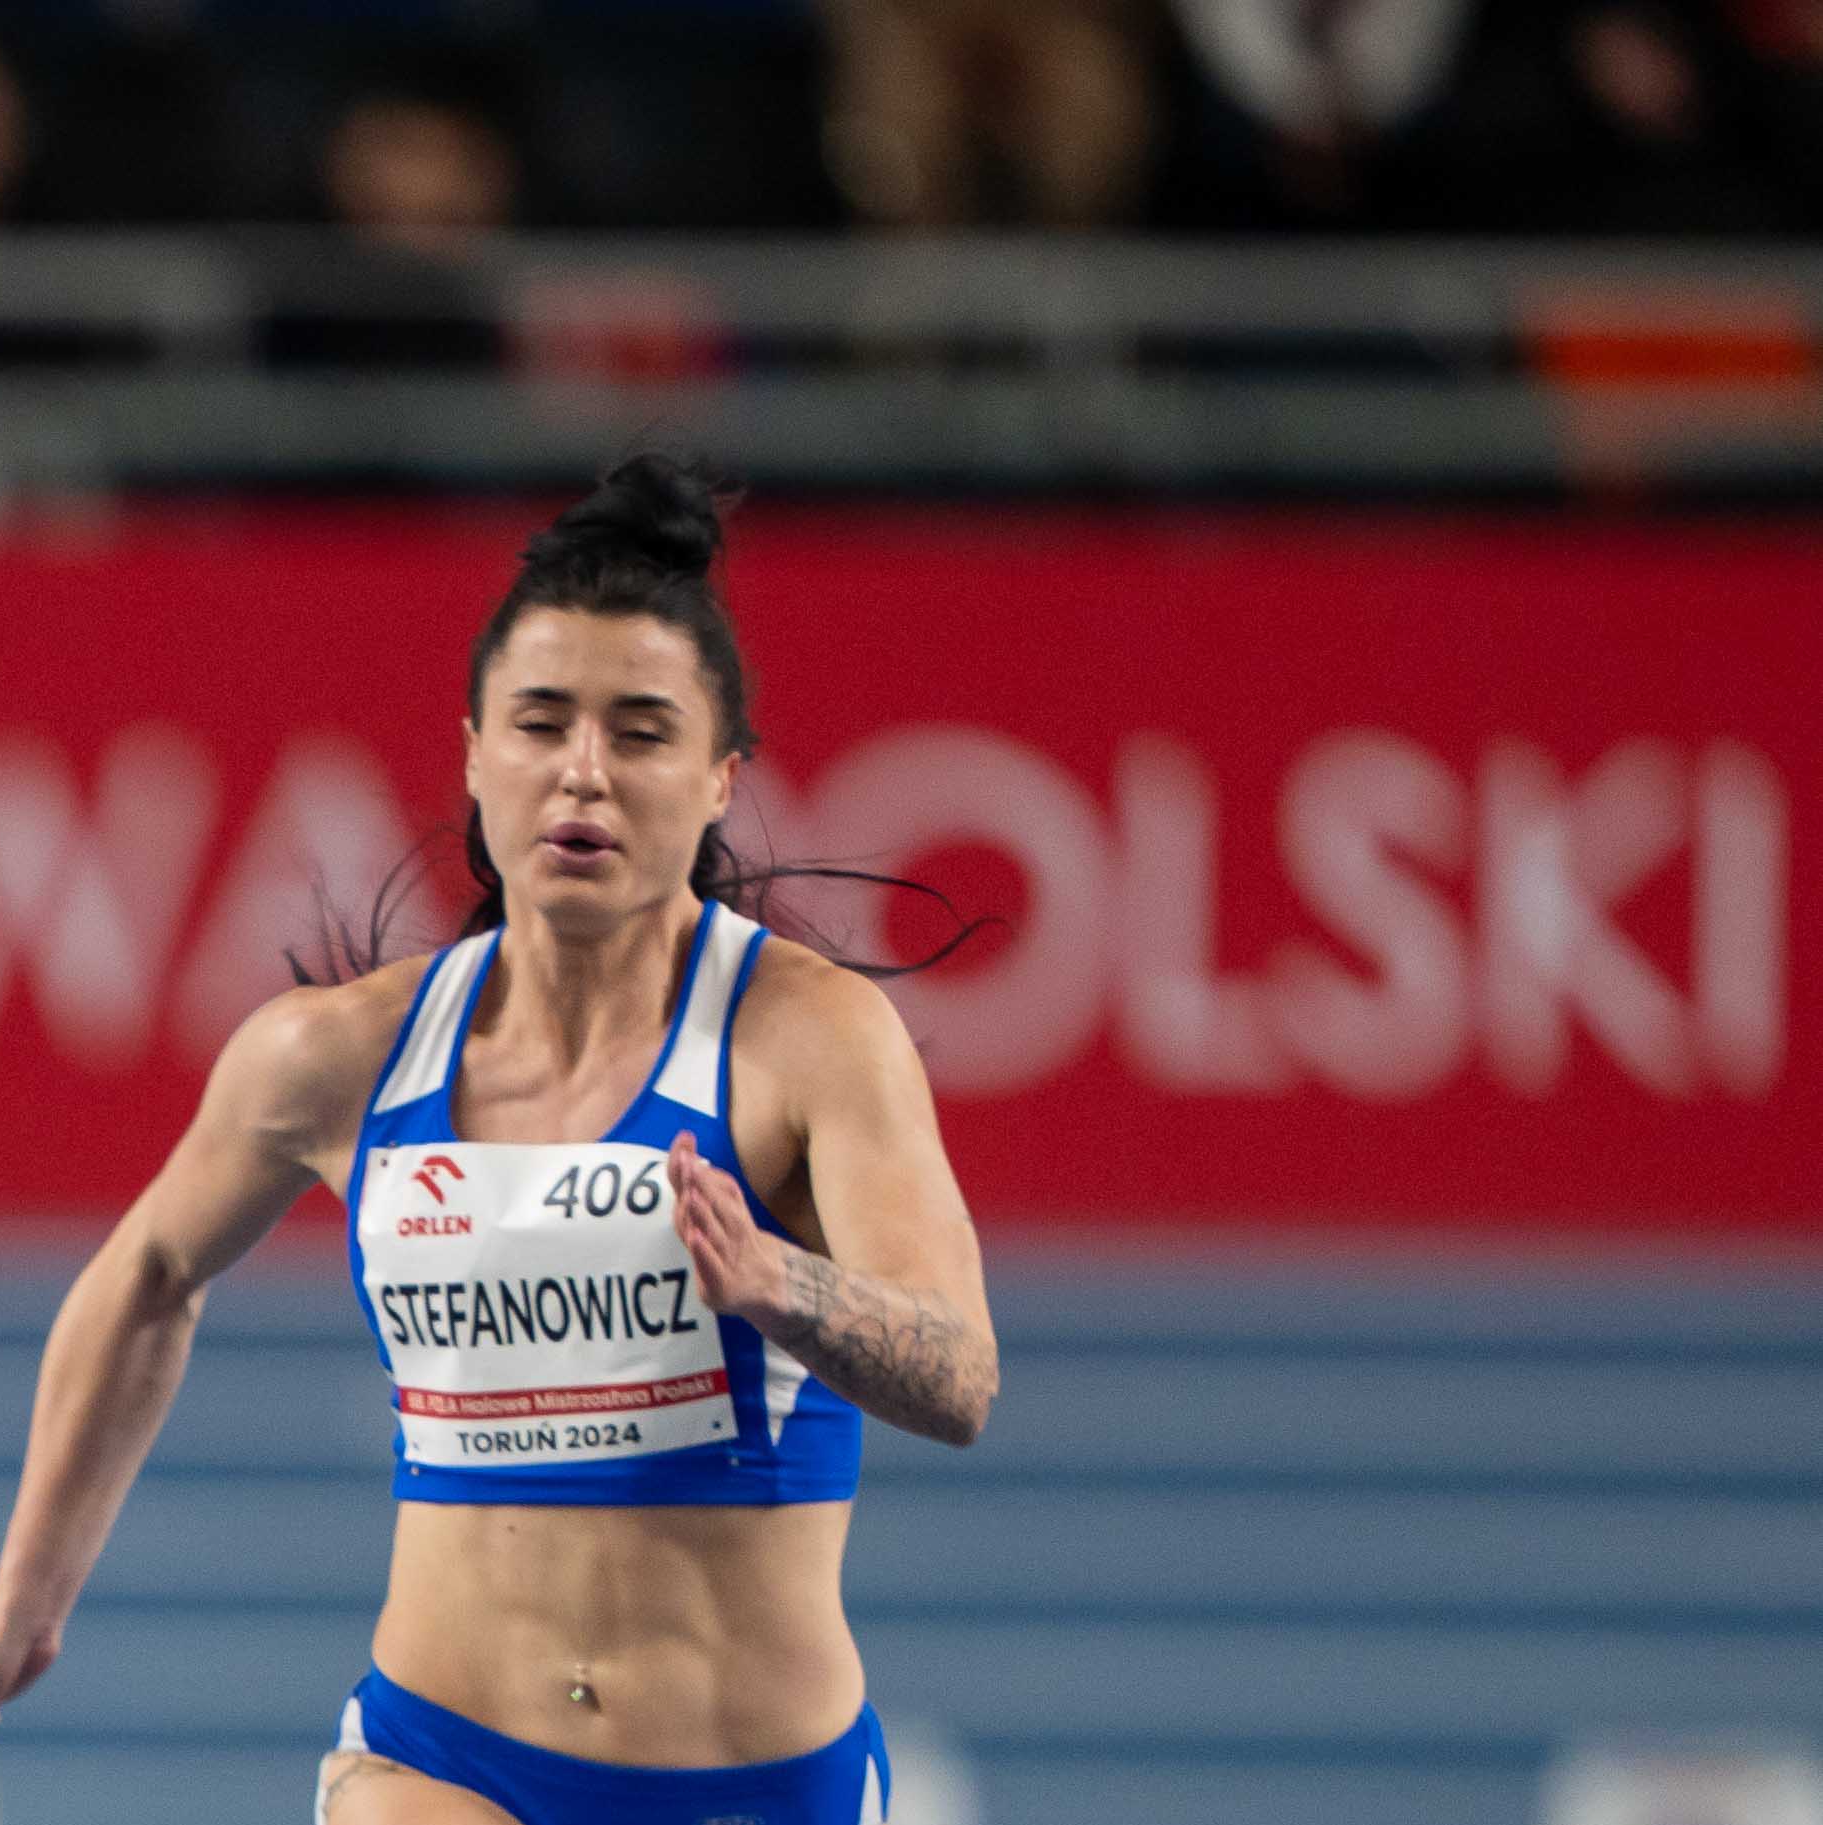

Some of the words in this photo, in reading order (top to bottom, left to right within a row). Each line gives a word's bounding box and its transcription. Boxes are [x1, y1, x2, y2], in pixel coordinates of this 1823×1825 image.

[730, 725, 1788, 1102] OLSKI
[543, 1160, 663, 1219] 406
[396, 1215, 473, 1238] ORLEN
[380, 1266, 697, 1348] STEFANOWICZ
[457, 1420, 558, 1454] TORUŃ
[565, 1421, 643, 1449] 2024
